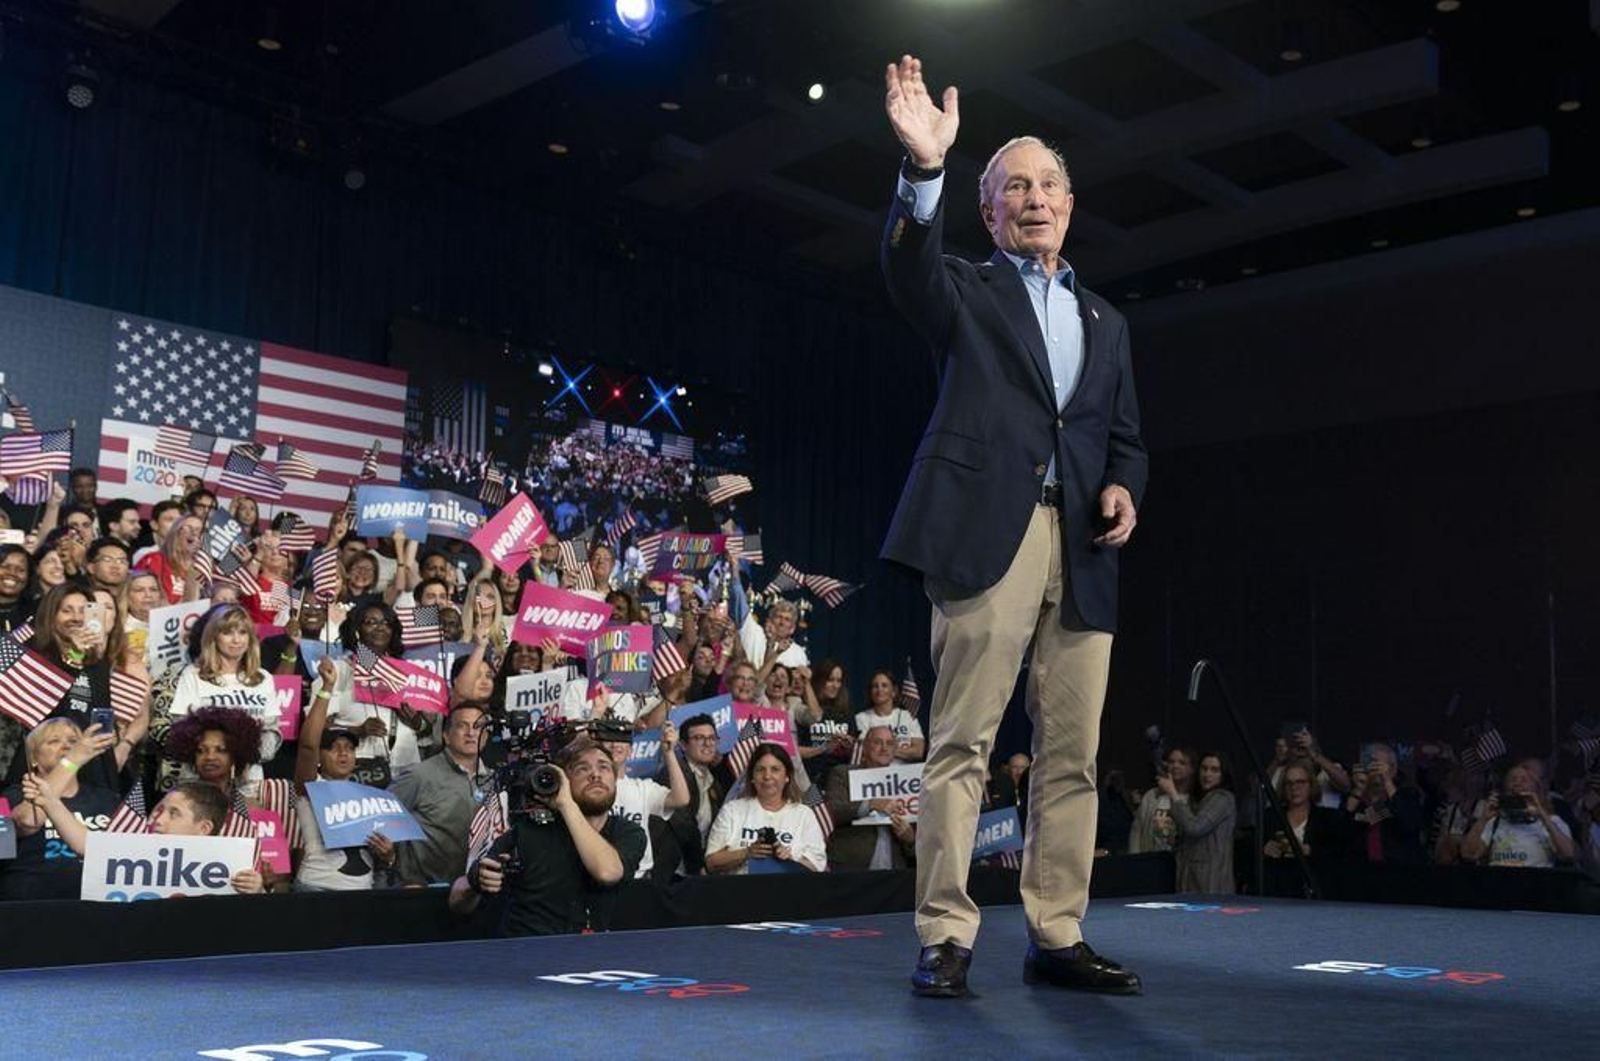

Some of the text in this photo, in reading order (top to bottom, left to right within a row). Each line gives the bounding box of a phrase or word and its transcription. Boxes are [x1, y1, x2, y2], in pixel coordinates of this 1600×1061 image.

[134, 465, 176, 487] 2020
[362, 501, 426, 519] WOMEN
[490, 502, 536, 562] WOMEN
[522, 605, 605, 632] WOMEN
[611, 652, 648, 672] MIKE
[516, 675, 562, 707] mike
[810, 720, 849, 735] mike
[862, 773, 921, 799] mike
[324, 797, 403, 826] WOMEN
[105, 848, 230, 890] mike
